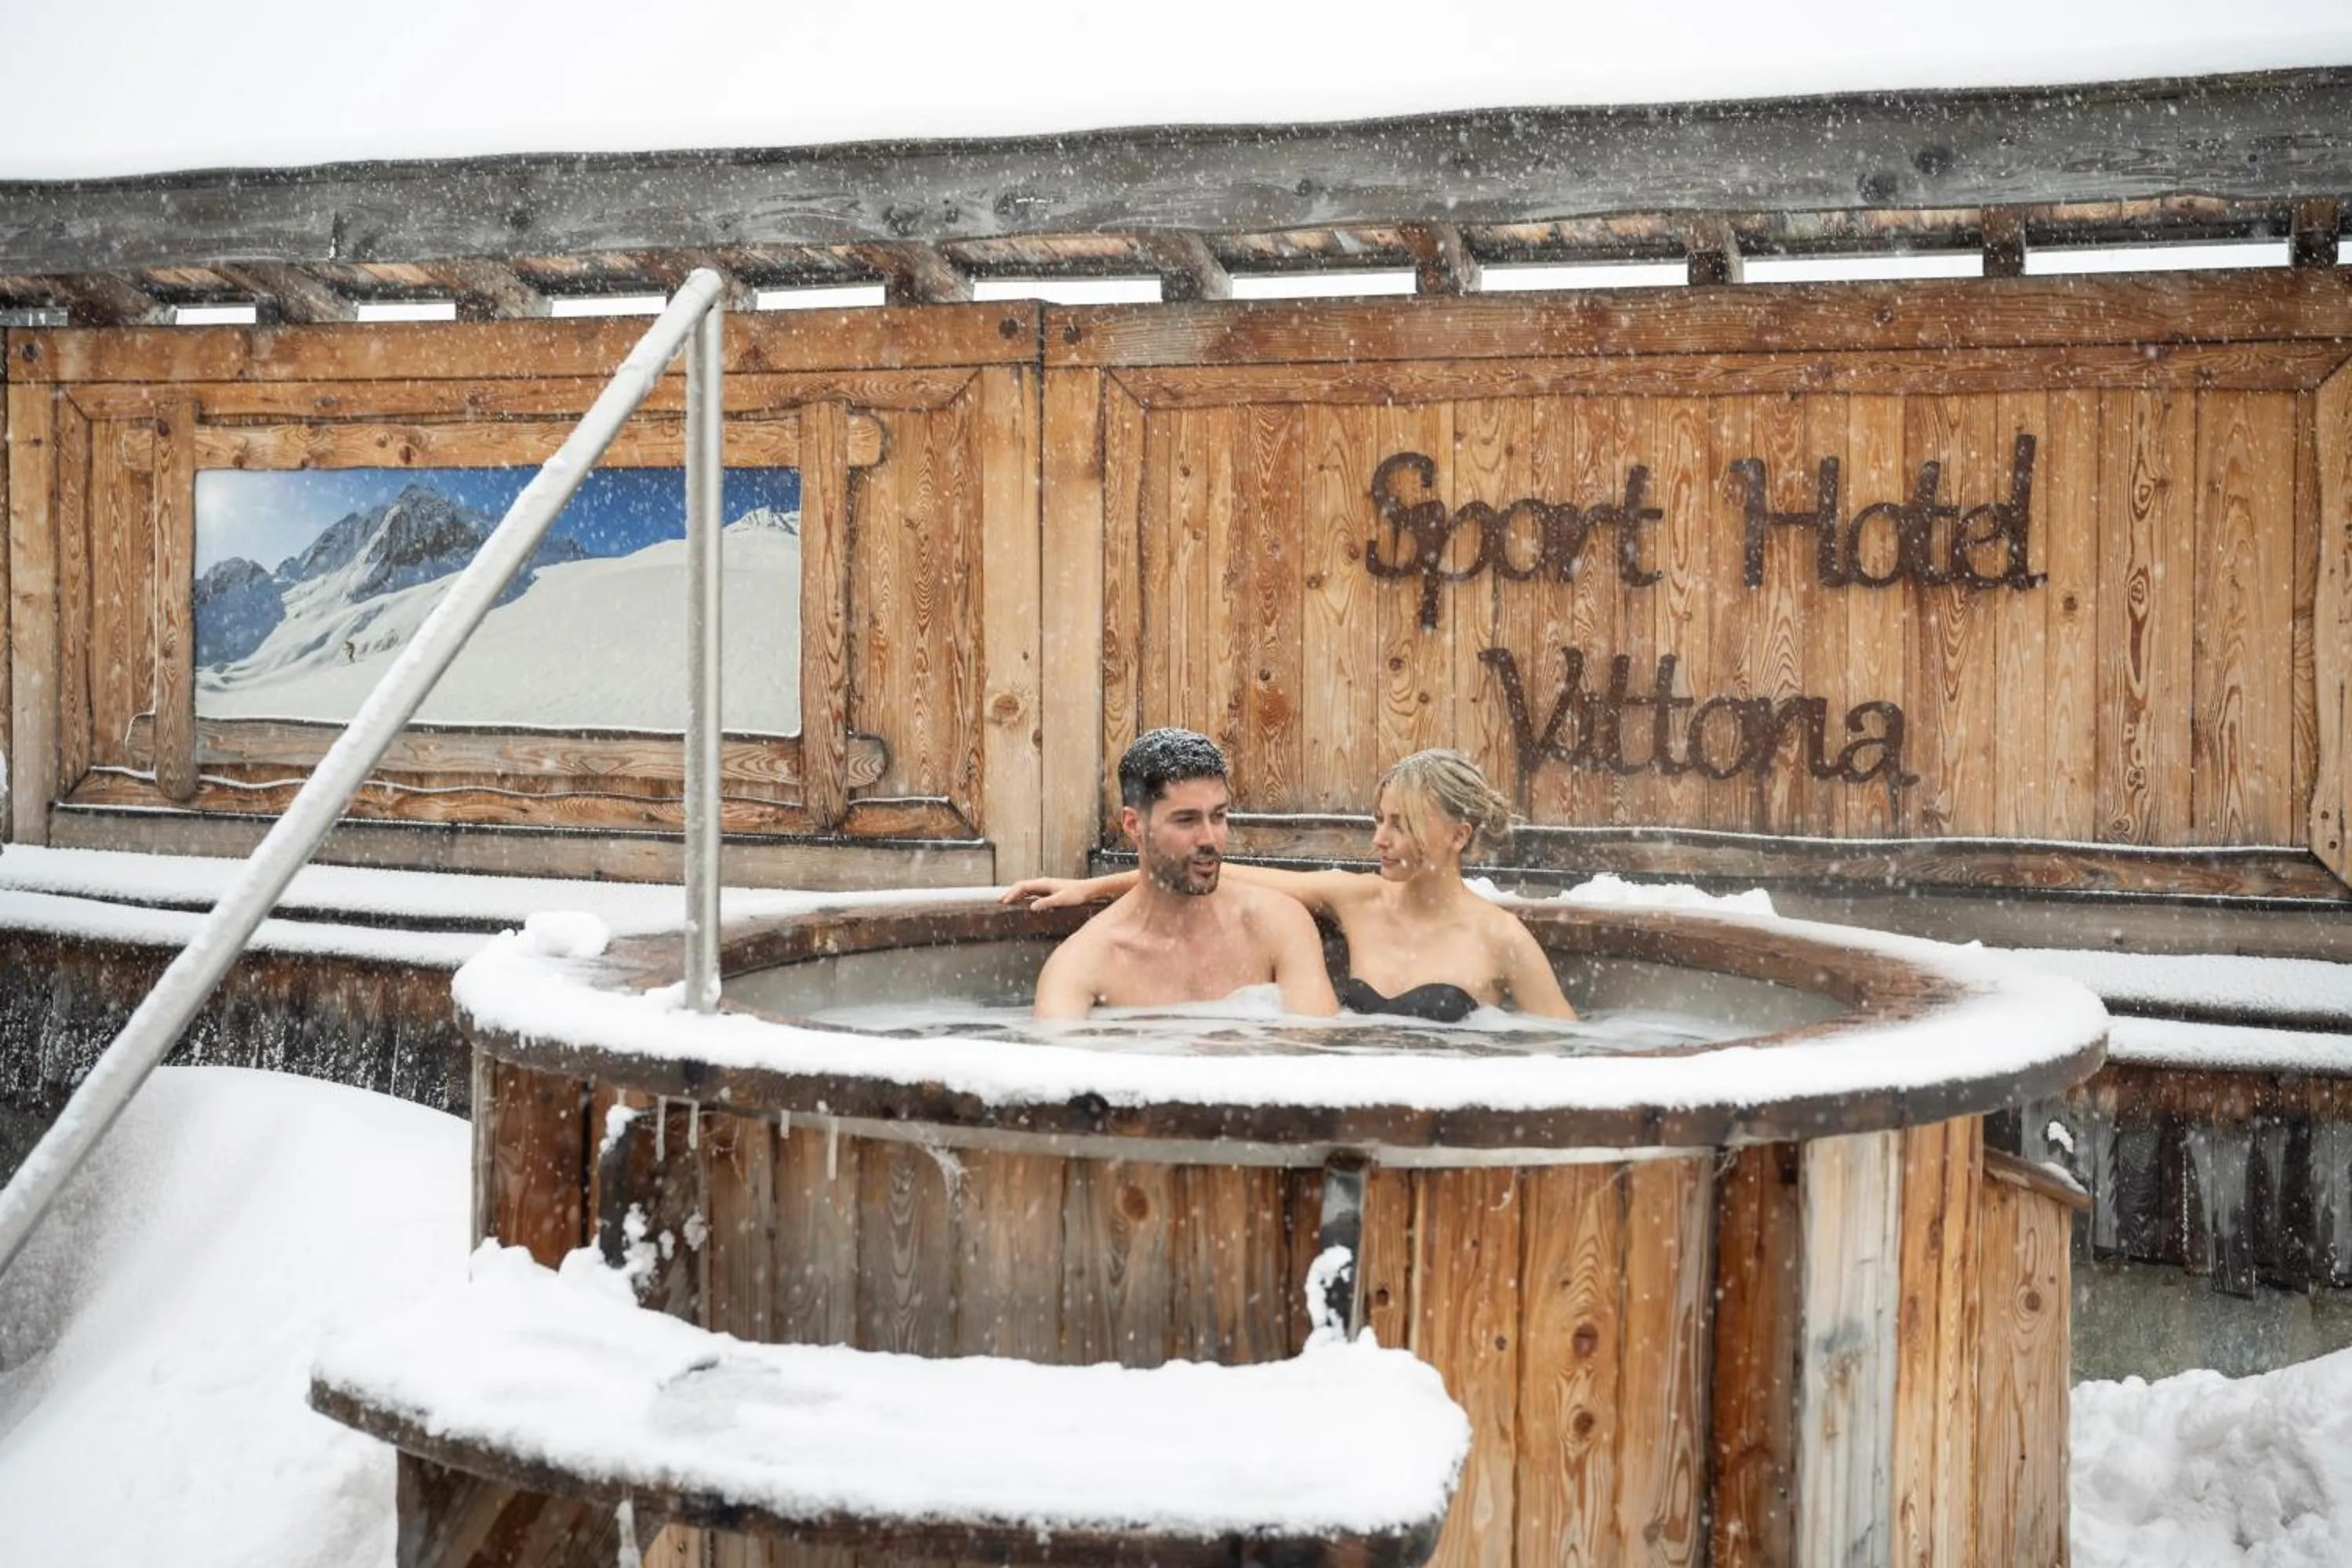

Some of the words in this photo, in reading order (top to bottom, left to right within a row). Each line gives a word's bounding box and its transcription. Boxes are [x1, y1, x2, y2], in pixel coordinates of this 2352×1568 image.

[1366, 452, 1663, 629] Sport
[1730, 434, 2048, 591] Hotel
[1478, 647, 1921, 787] Vittoria
